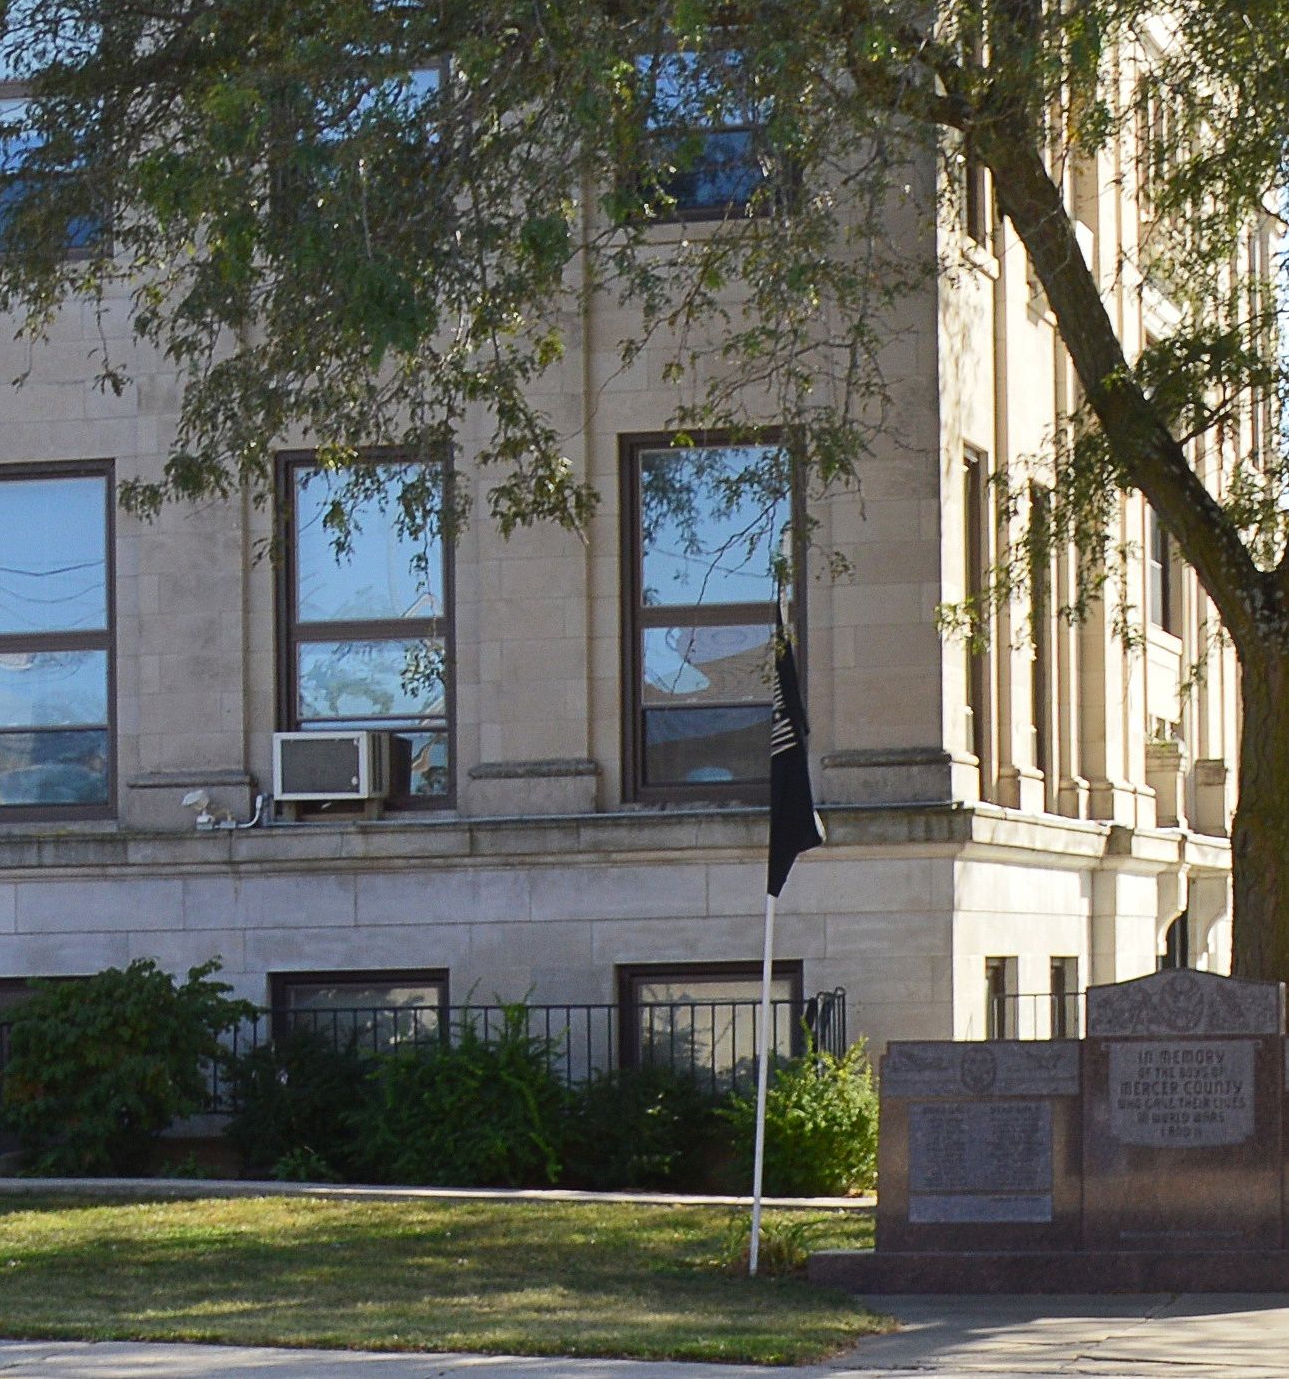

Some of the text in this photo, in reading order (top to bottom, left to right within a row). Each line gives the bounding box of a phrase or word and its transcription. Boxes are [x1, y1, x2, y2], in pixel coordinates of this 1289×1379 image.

[1159, 1049, 1225, 1064] MEMORY
[1120, 1080, 1243, 1096] MERCER COUNTY
